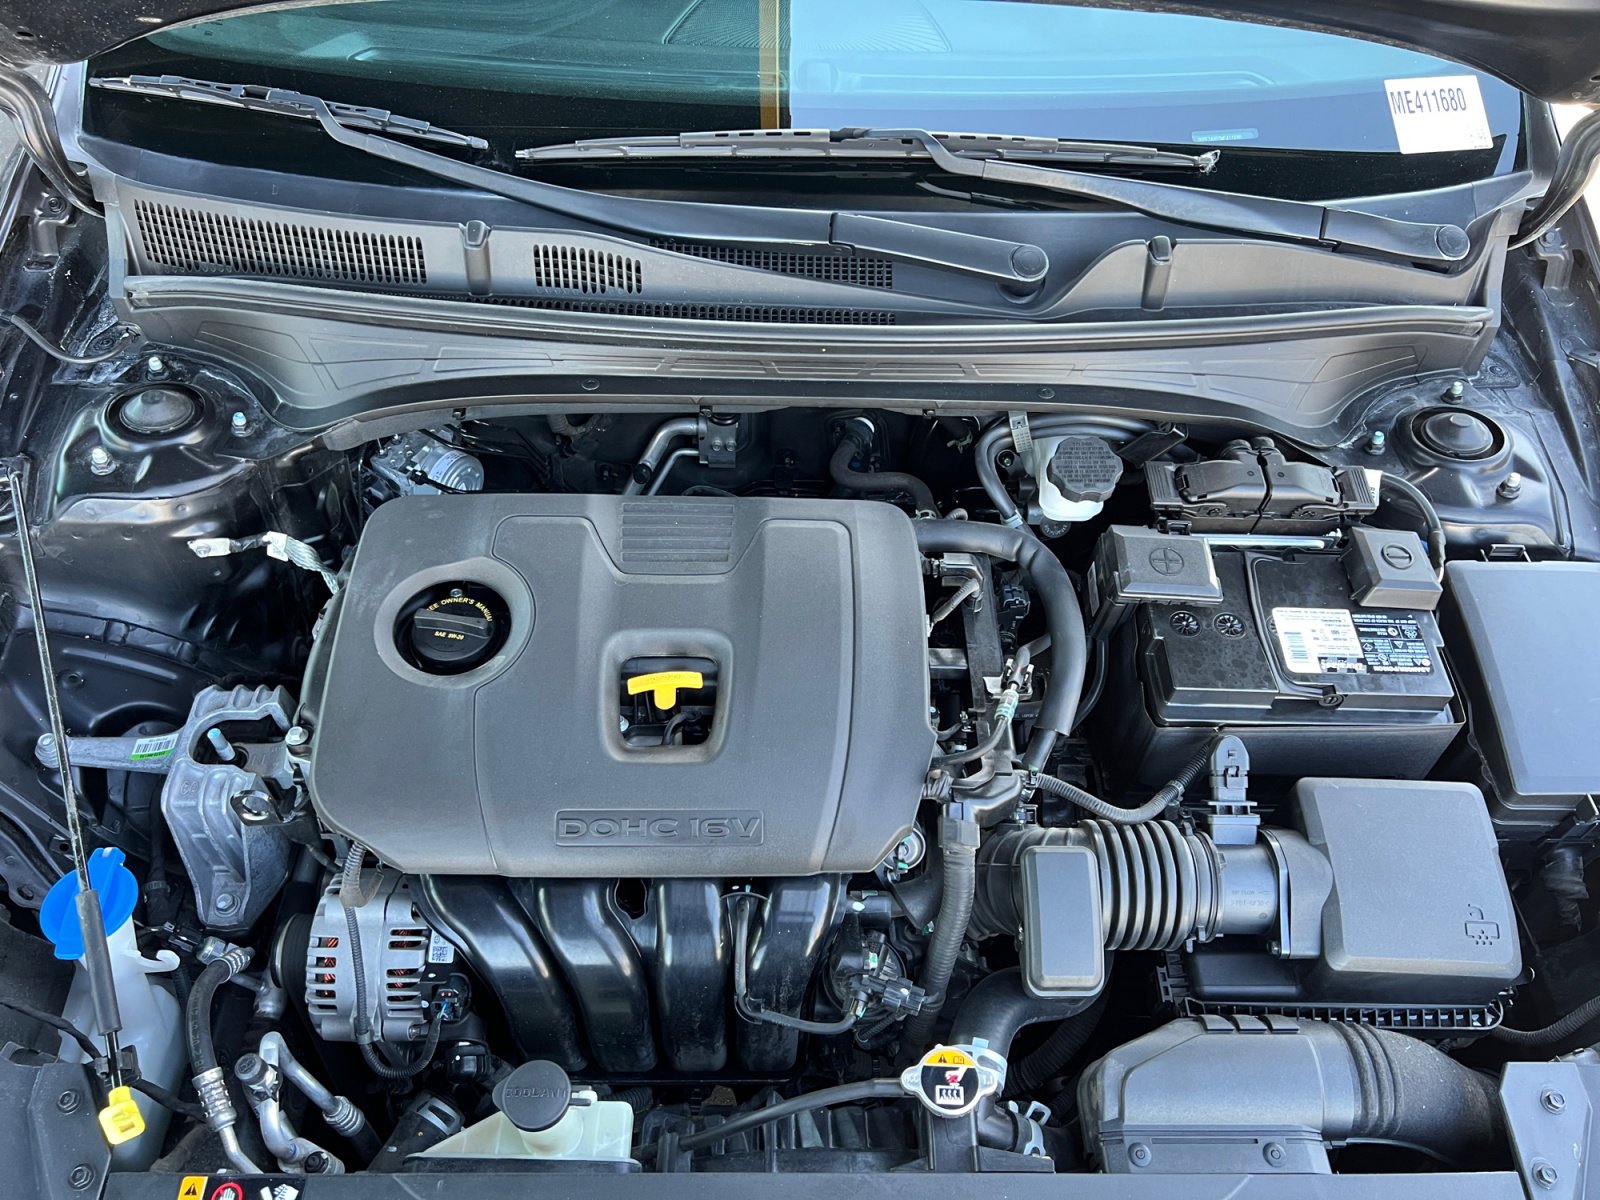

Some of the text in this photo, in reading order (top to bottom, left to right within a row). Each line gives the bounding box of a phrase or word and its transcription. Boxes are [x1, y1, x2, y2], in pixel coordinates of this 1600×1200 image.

[1389, 87, 1467, 115] ME411680
[441, 597, 475, 605] OWNER'S
[558, 817, 760, 838] DOHC 16V
[505, 1087, 570, 1098] COOLANT
